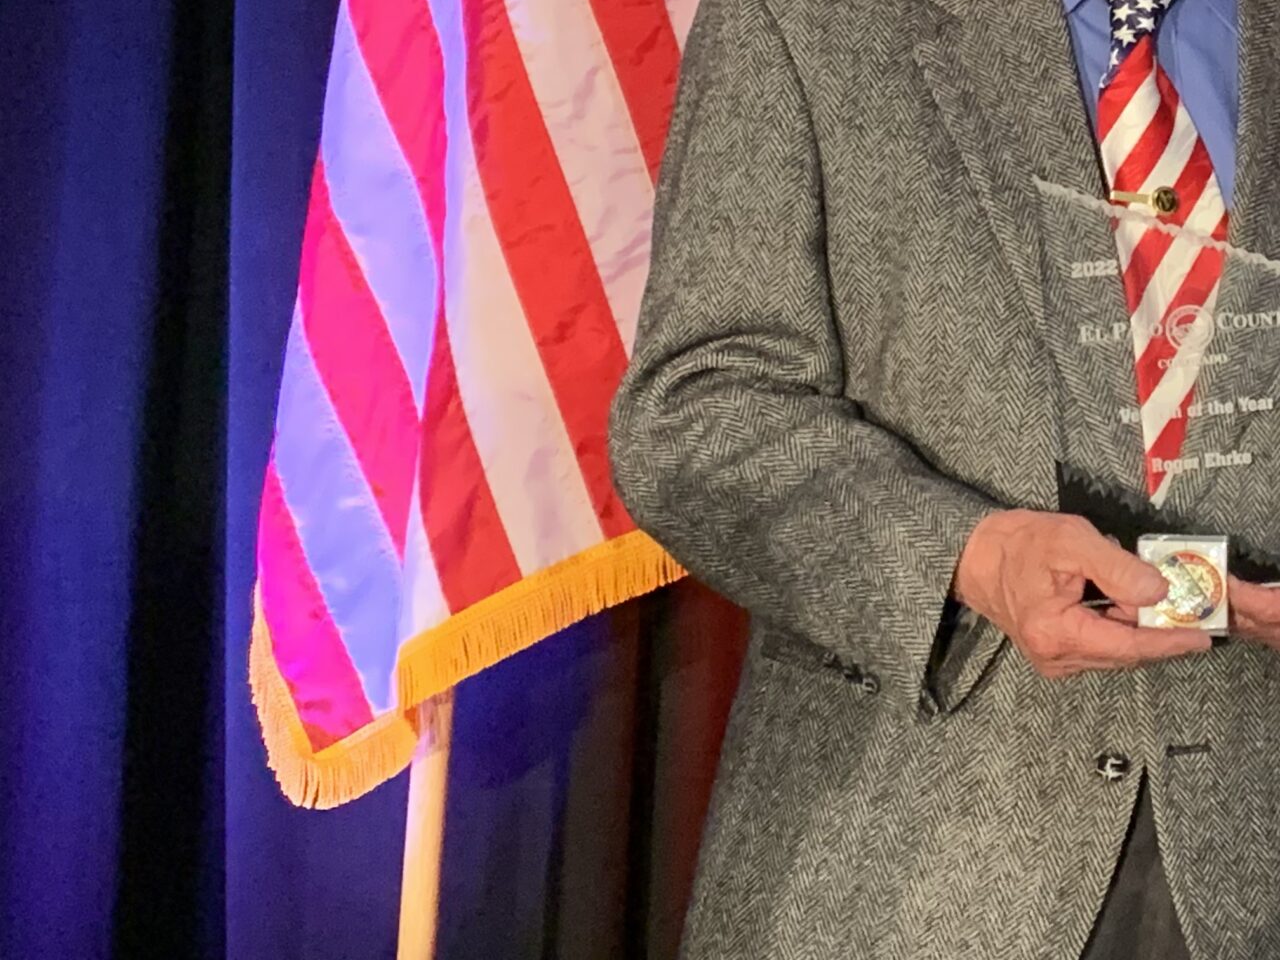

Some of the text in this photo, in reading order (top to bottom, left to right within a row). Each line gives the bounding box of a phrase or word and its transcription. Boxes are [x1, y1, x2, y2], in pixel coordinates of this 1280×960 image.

[1071, 260, 1118, 278] 2022
[1112, 321, 1163, 340] PO
[1157, 353, 1228, 370] COADO
[1208, 400, 1234, 415] the
[1238, 396, 1274, 412] Year
